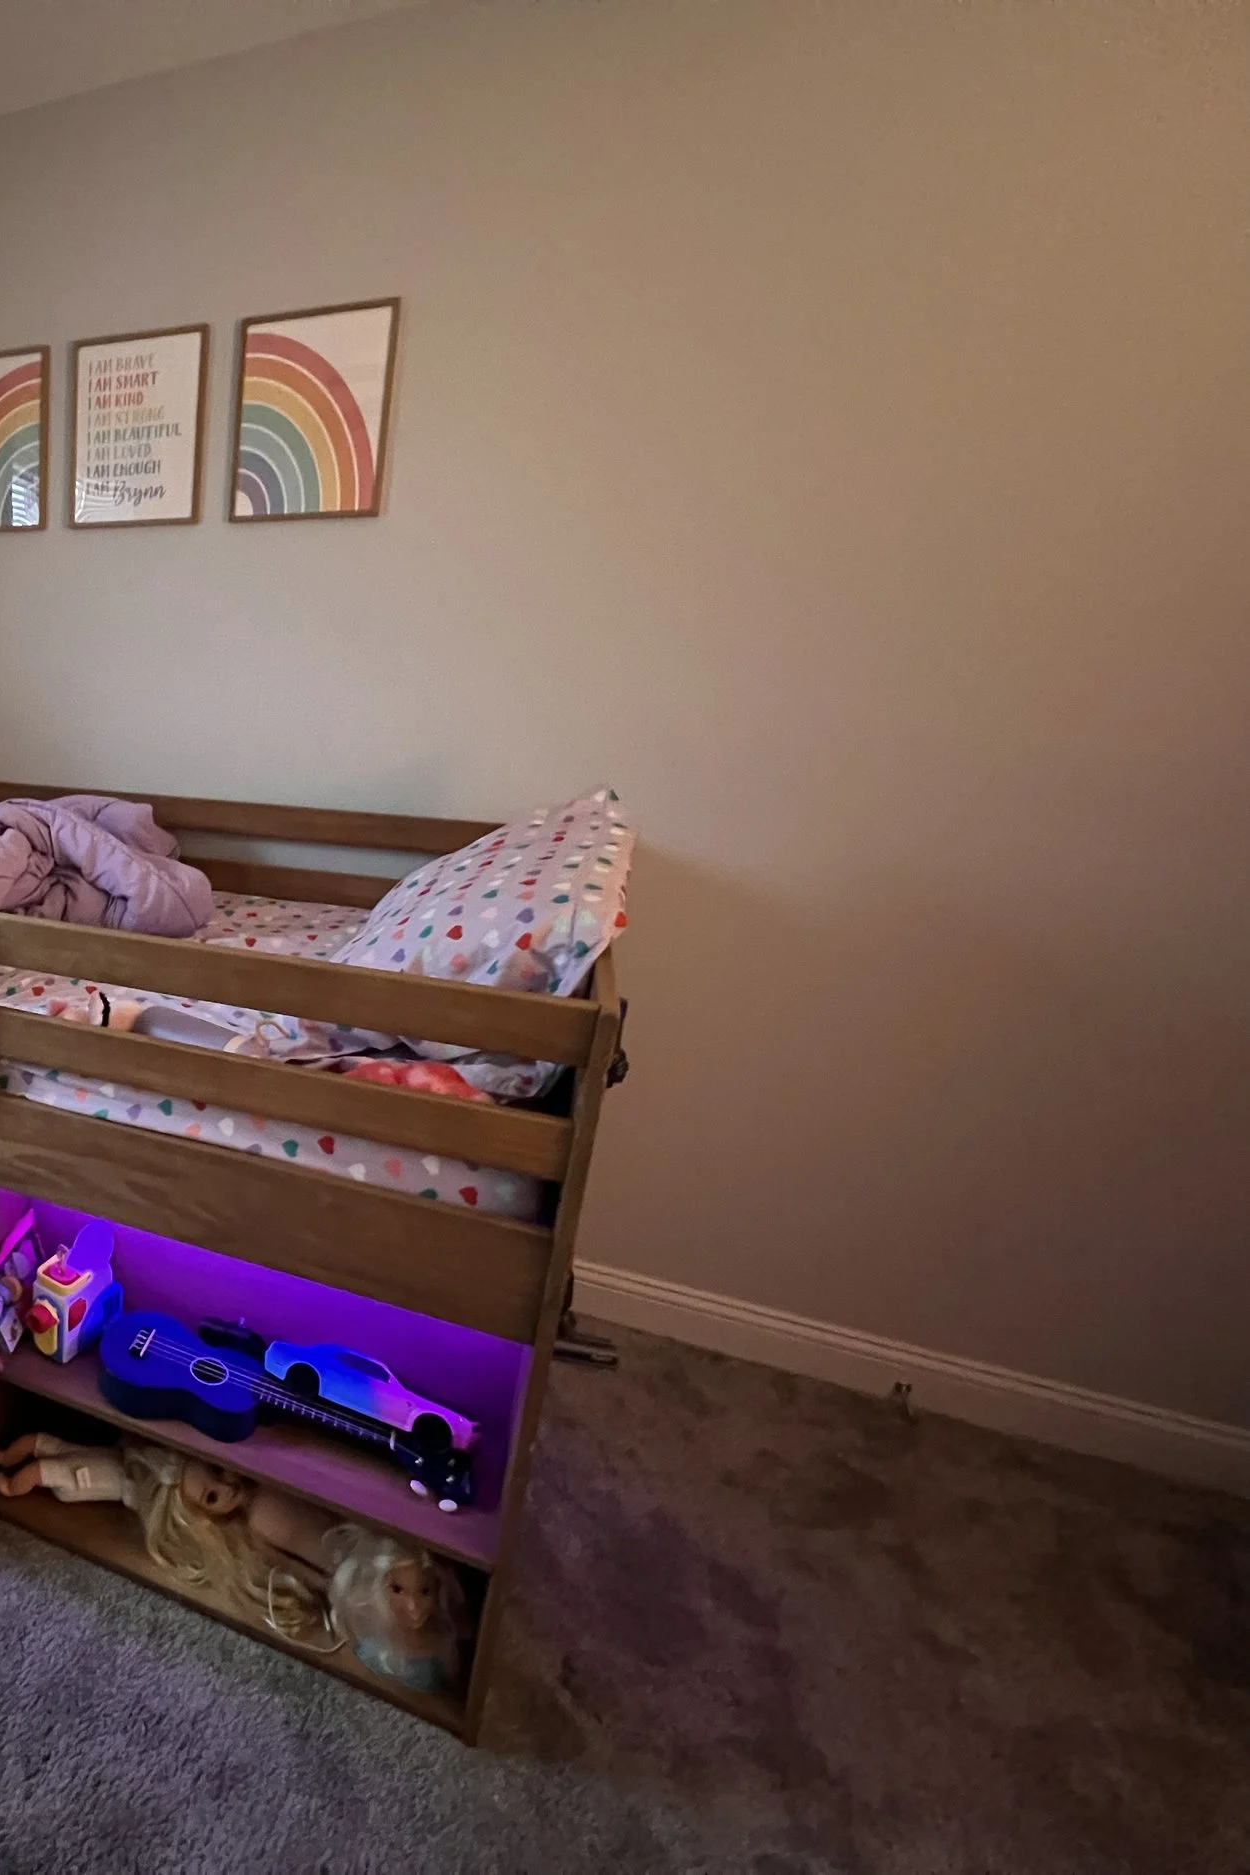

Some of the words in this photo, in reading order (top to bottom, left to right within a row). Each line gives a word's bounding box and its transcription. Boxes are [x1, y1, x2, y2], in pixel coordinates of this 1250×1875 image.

[95, 358, 112, 374] AM
[115, 353, 155, 372] BRAVE
[94, 376, 112, 391] AM
[115, 371, 159, 390] SMART
[94, 393, 111, 409] AM
[114, 391, 144, 407] KIND
[93, 428, 111, 444] AM
[114, 422, 182, 443] BEAUTIFUL
[93, 446, 110, 461] AM
[113, 442, 152, 460] LOVED
[93, 463, 110, 478] AM
[112, 459, 162, 478] ENOUGH
[112, 480, 166, 507] Brynn
